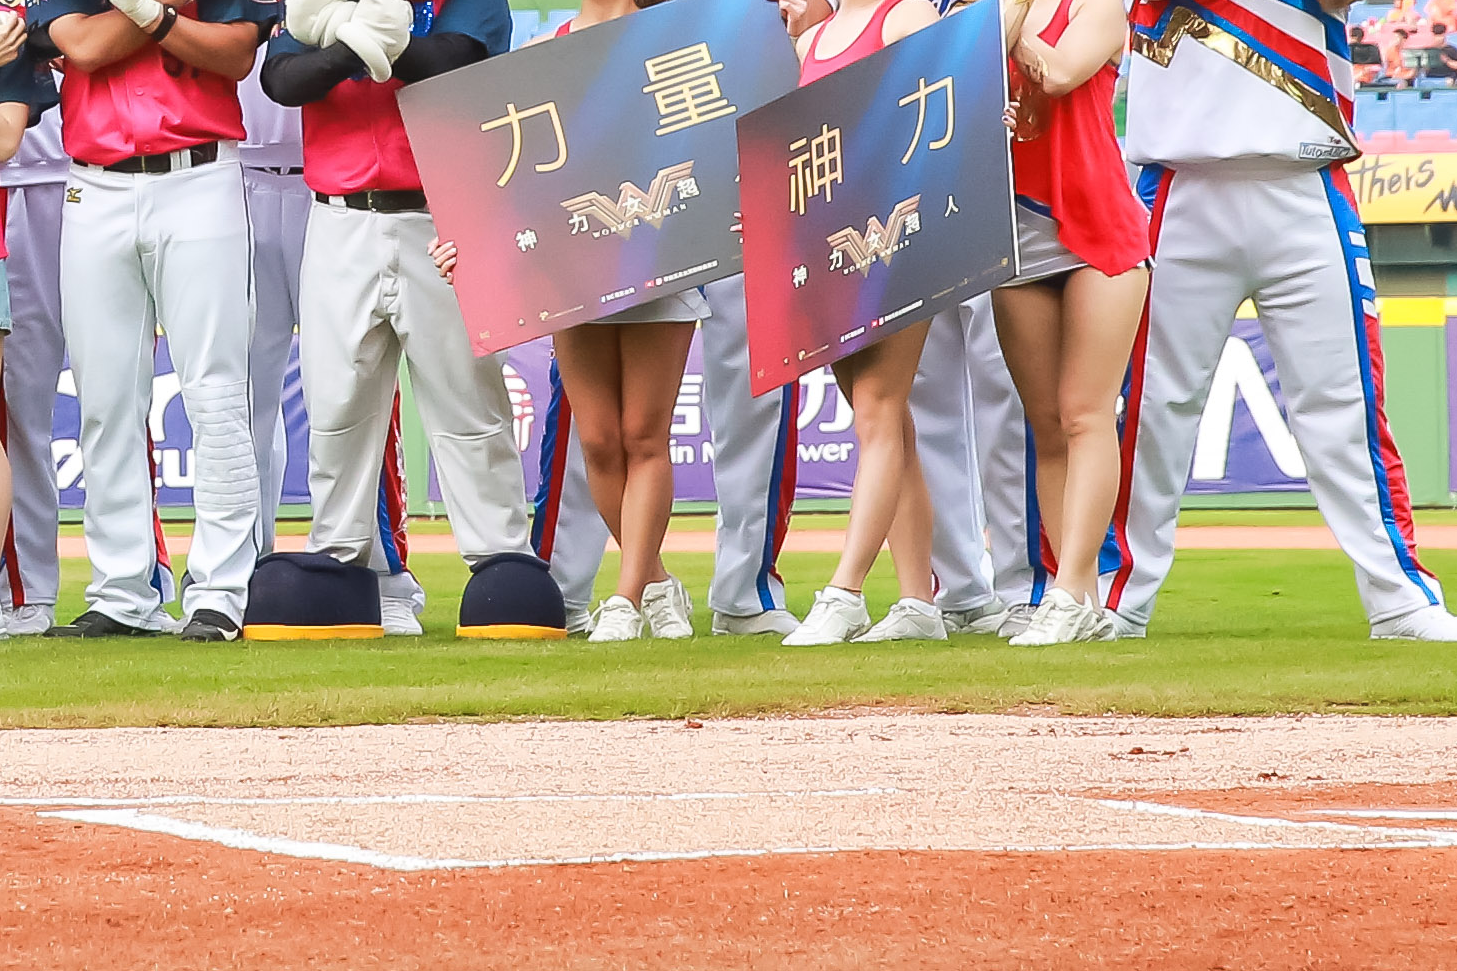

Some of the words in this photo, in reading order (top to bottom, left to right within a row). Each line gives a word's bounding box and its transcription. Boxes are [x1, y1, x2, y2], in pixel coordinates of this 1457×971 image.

[480, 41, 738, 188] 力量
[787, 74, 955, 216] 神力
[514, 176, 739, 253] 神力女超
[792, 194, 960, 289] 神力女超人
[797, 440, 854, 462] wer
